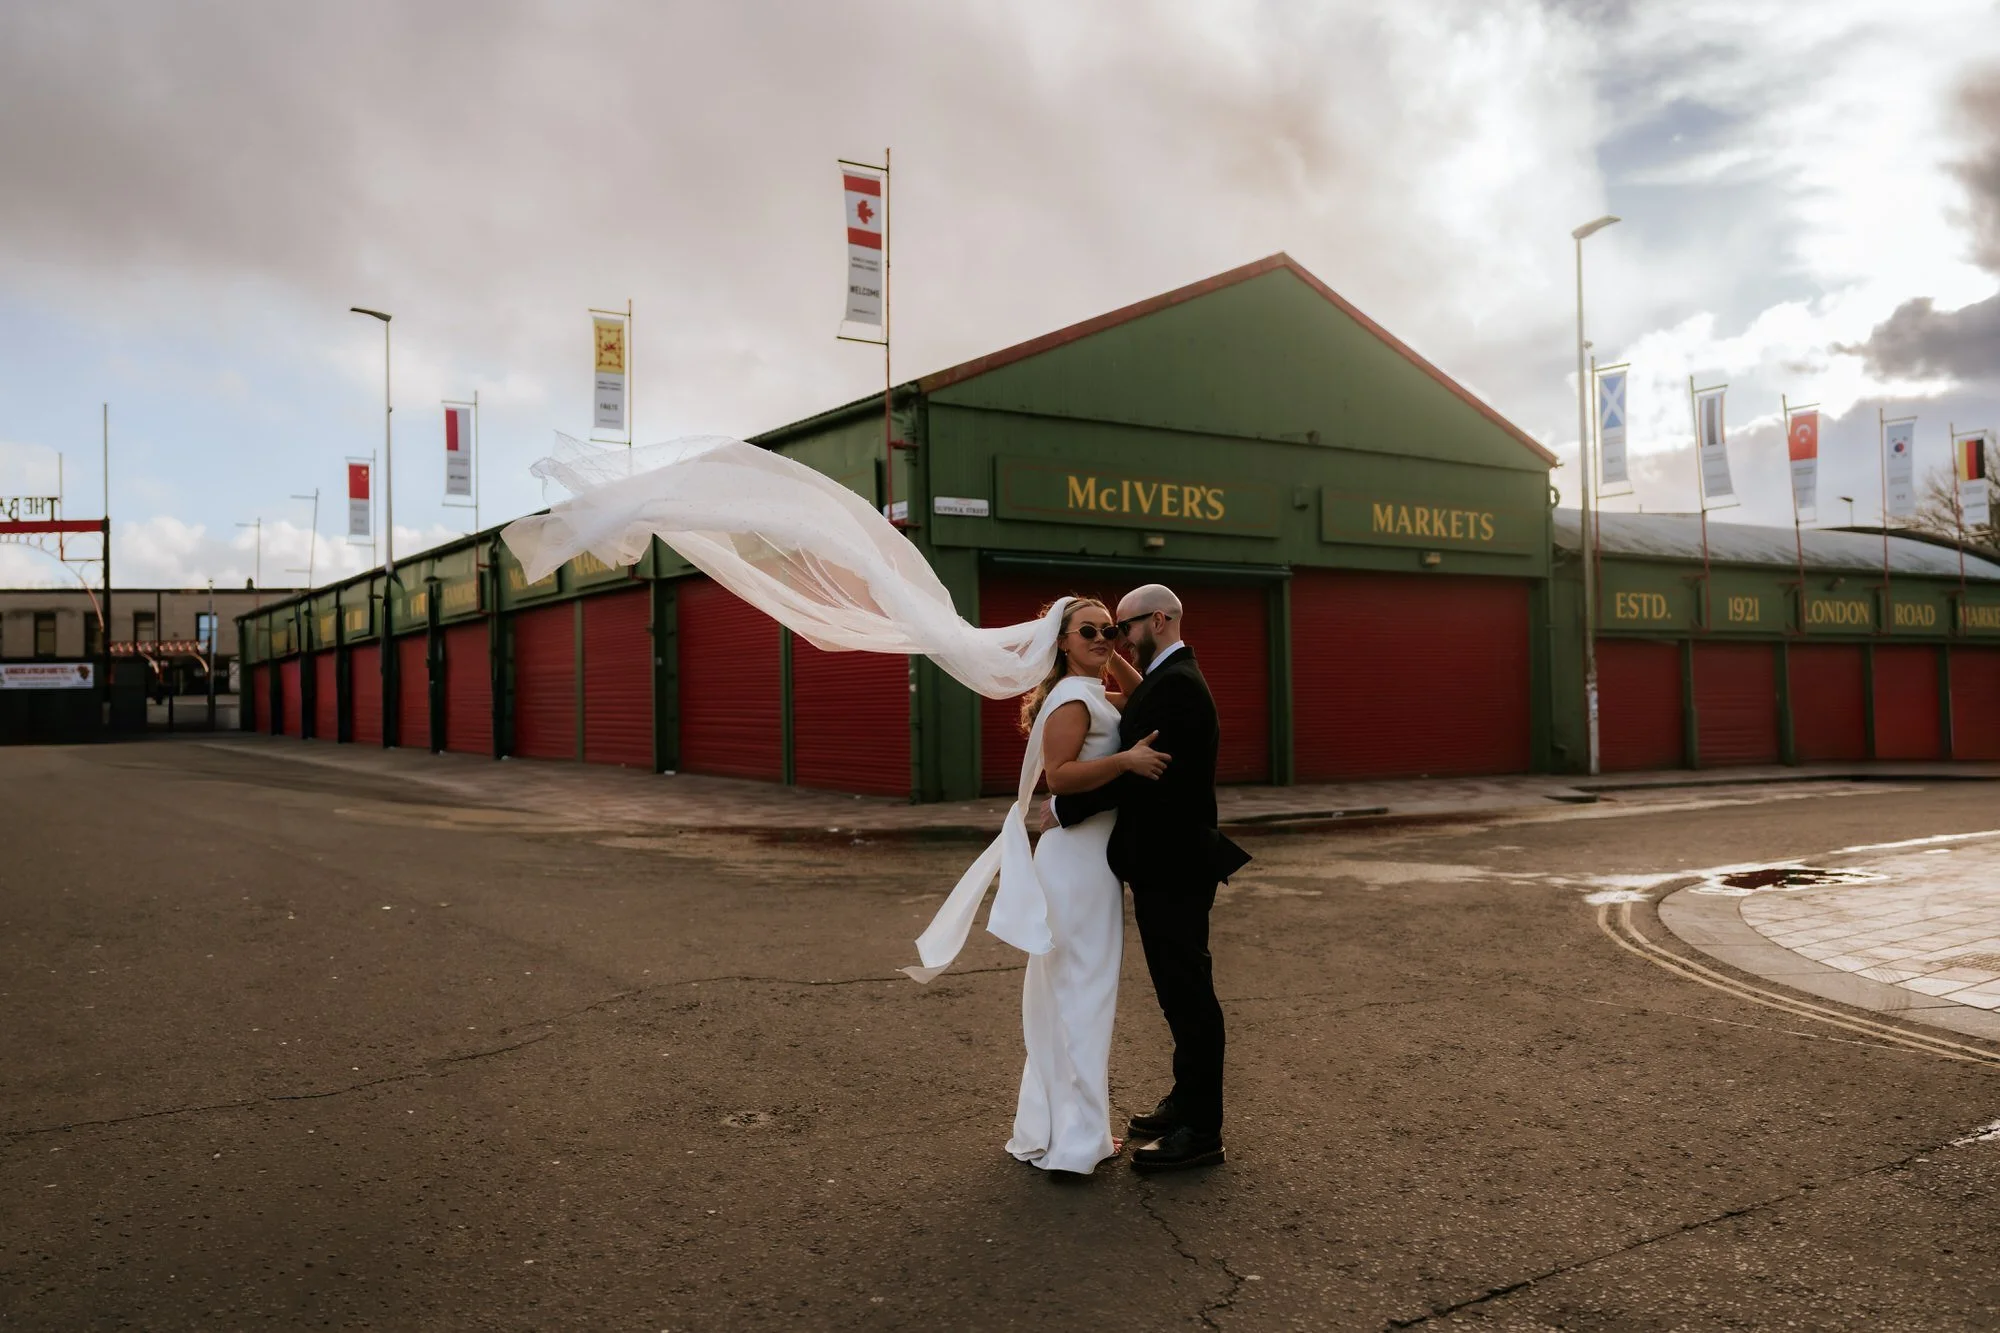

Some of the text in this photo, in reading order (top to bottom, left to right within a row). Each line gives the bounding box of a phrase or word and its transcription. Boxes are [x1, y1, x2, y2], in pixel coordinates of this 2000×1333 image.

[850, 285, 880, 298] WELCOME
[965, 507, 988, 515] STREET
[1067, 475, 1496, 541] McIVER'S MARKETS
[1615, 591, 1672, 619] ESTD.
[1727, 597, 1760, 622] 1921
[1804, 599, 1870, 625] LONDON
[1894, 603, 1937, 627] ROAD
